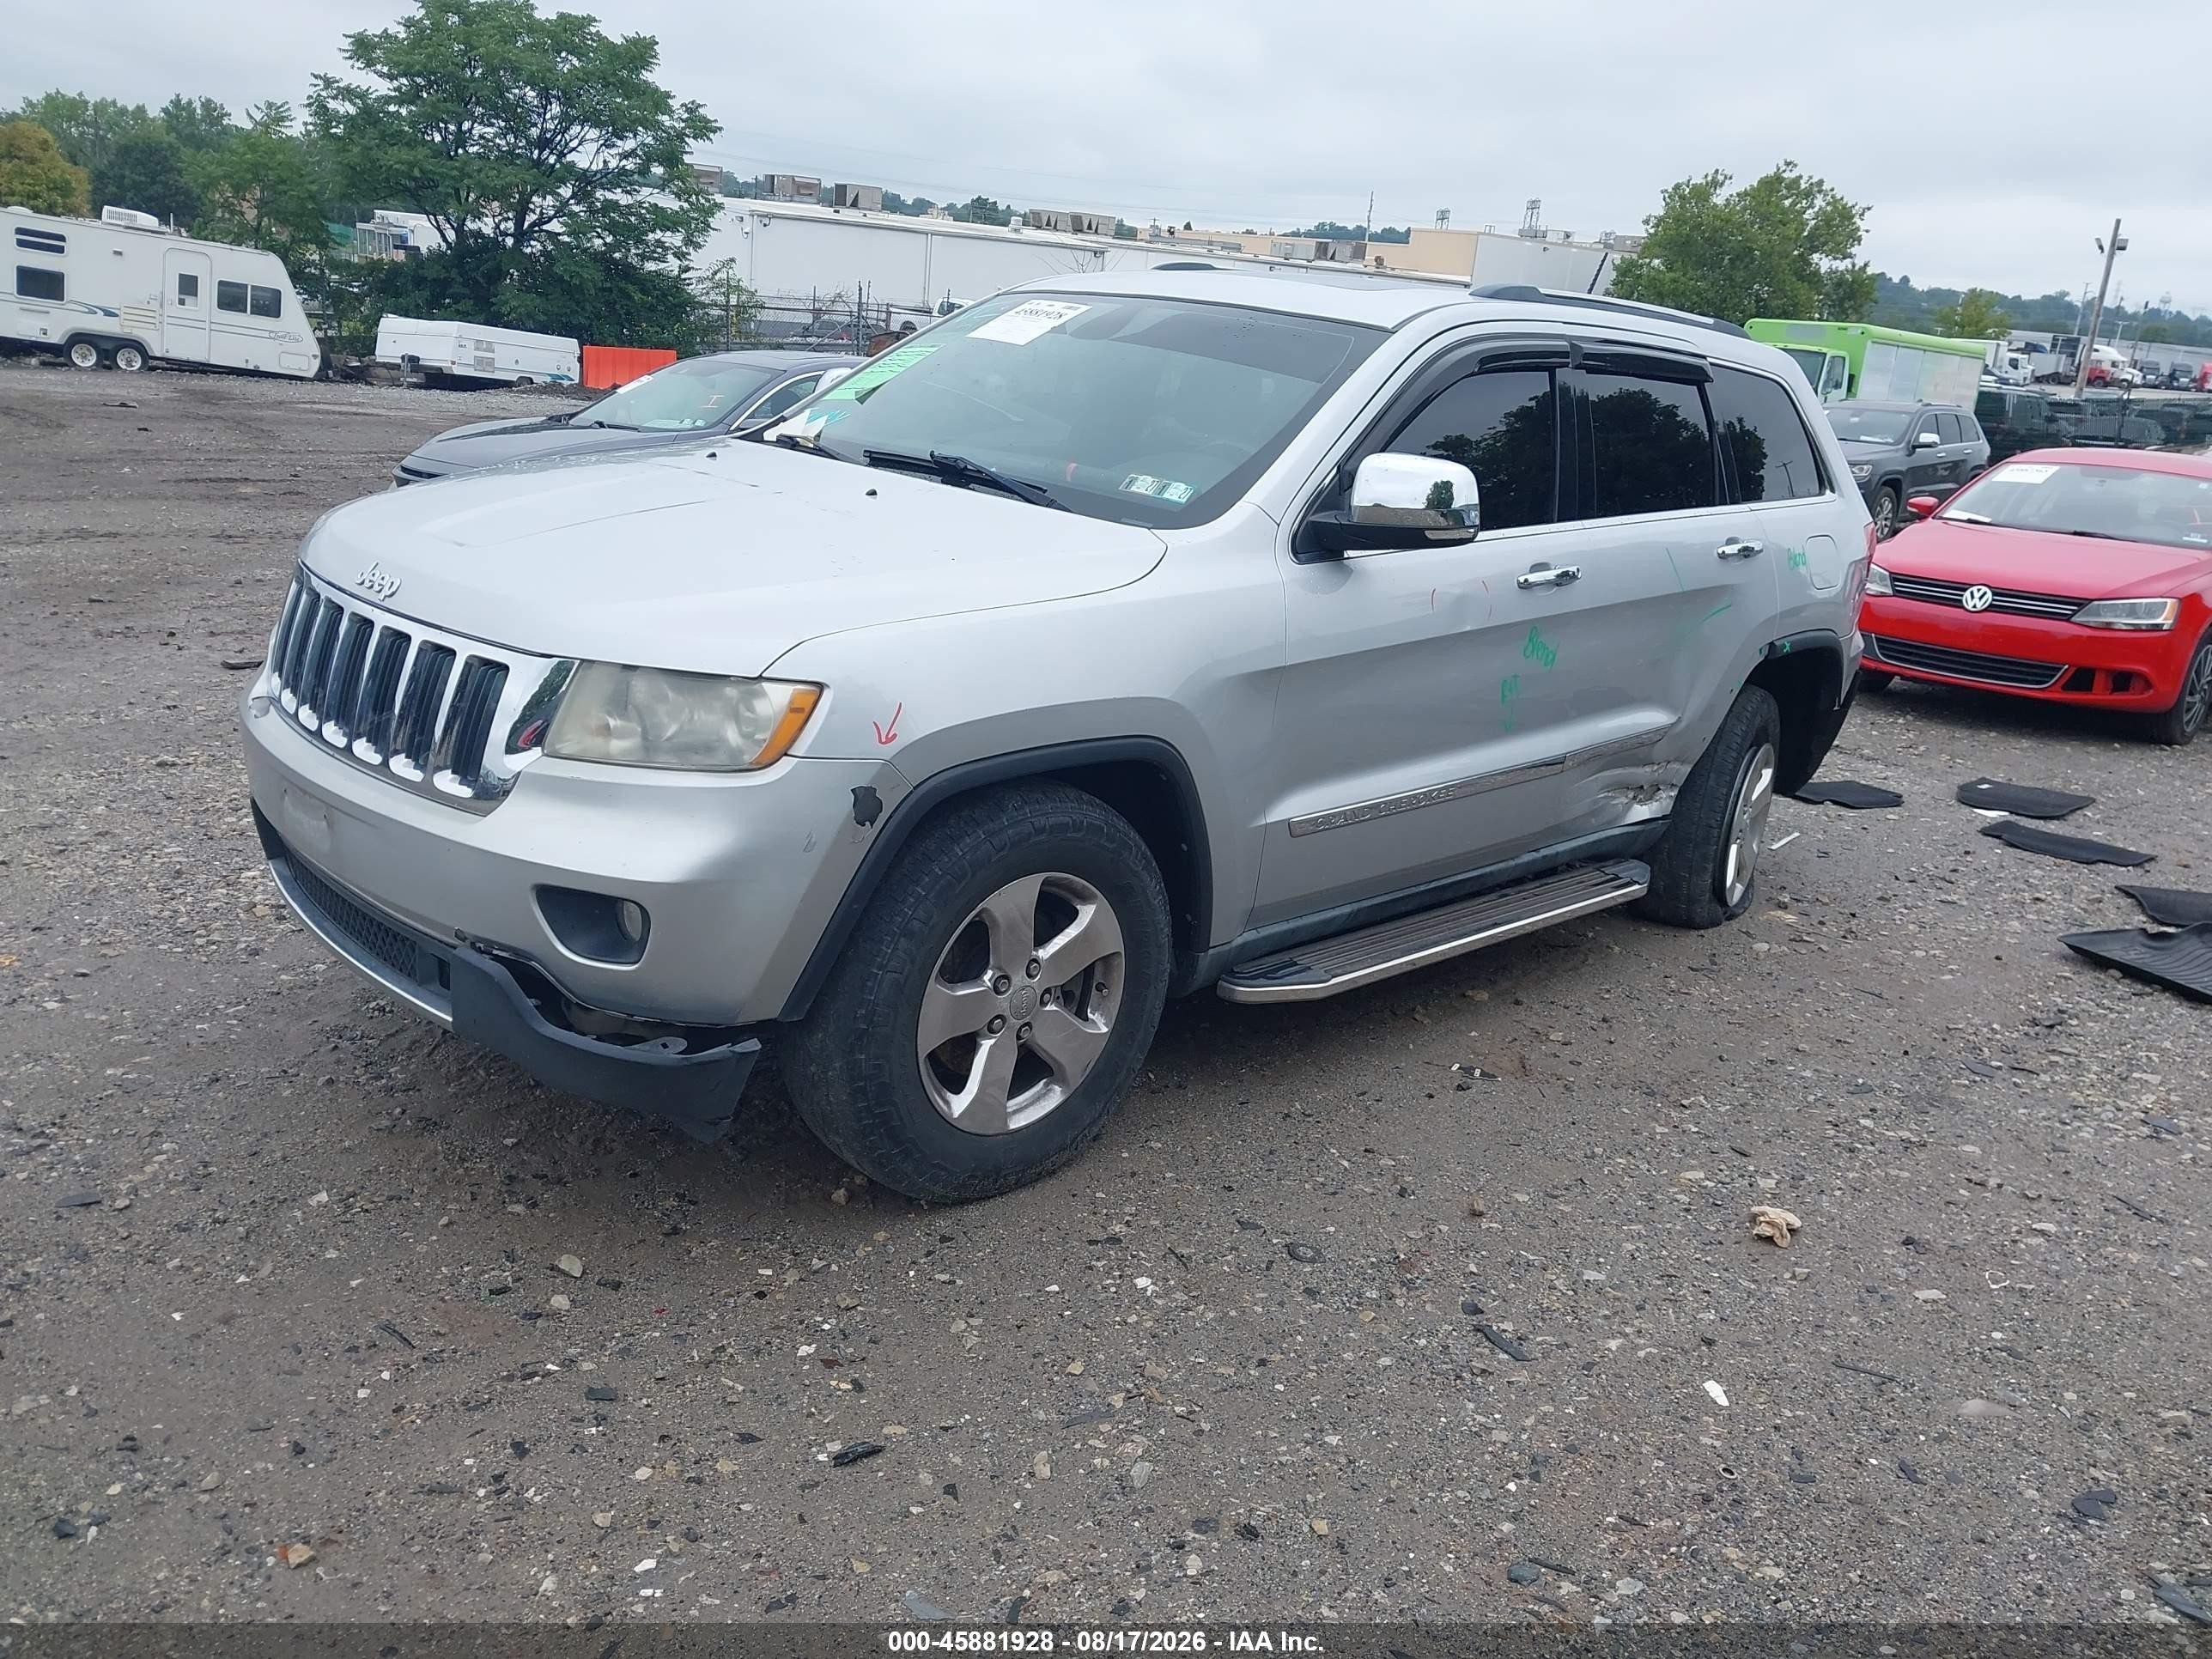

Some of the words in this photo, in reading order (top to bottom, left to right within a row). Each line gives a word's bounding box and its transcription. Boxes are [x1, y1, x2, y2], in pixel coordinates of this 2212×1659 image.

[355, 560, 402, 603] Jeep
[1316, 807, 1372, 830] GRAND
[1379, 787, 1456, 816] CHEROKEE
